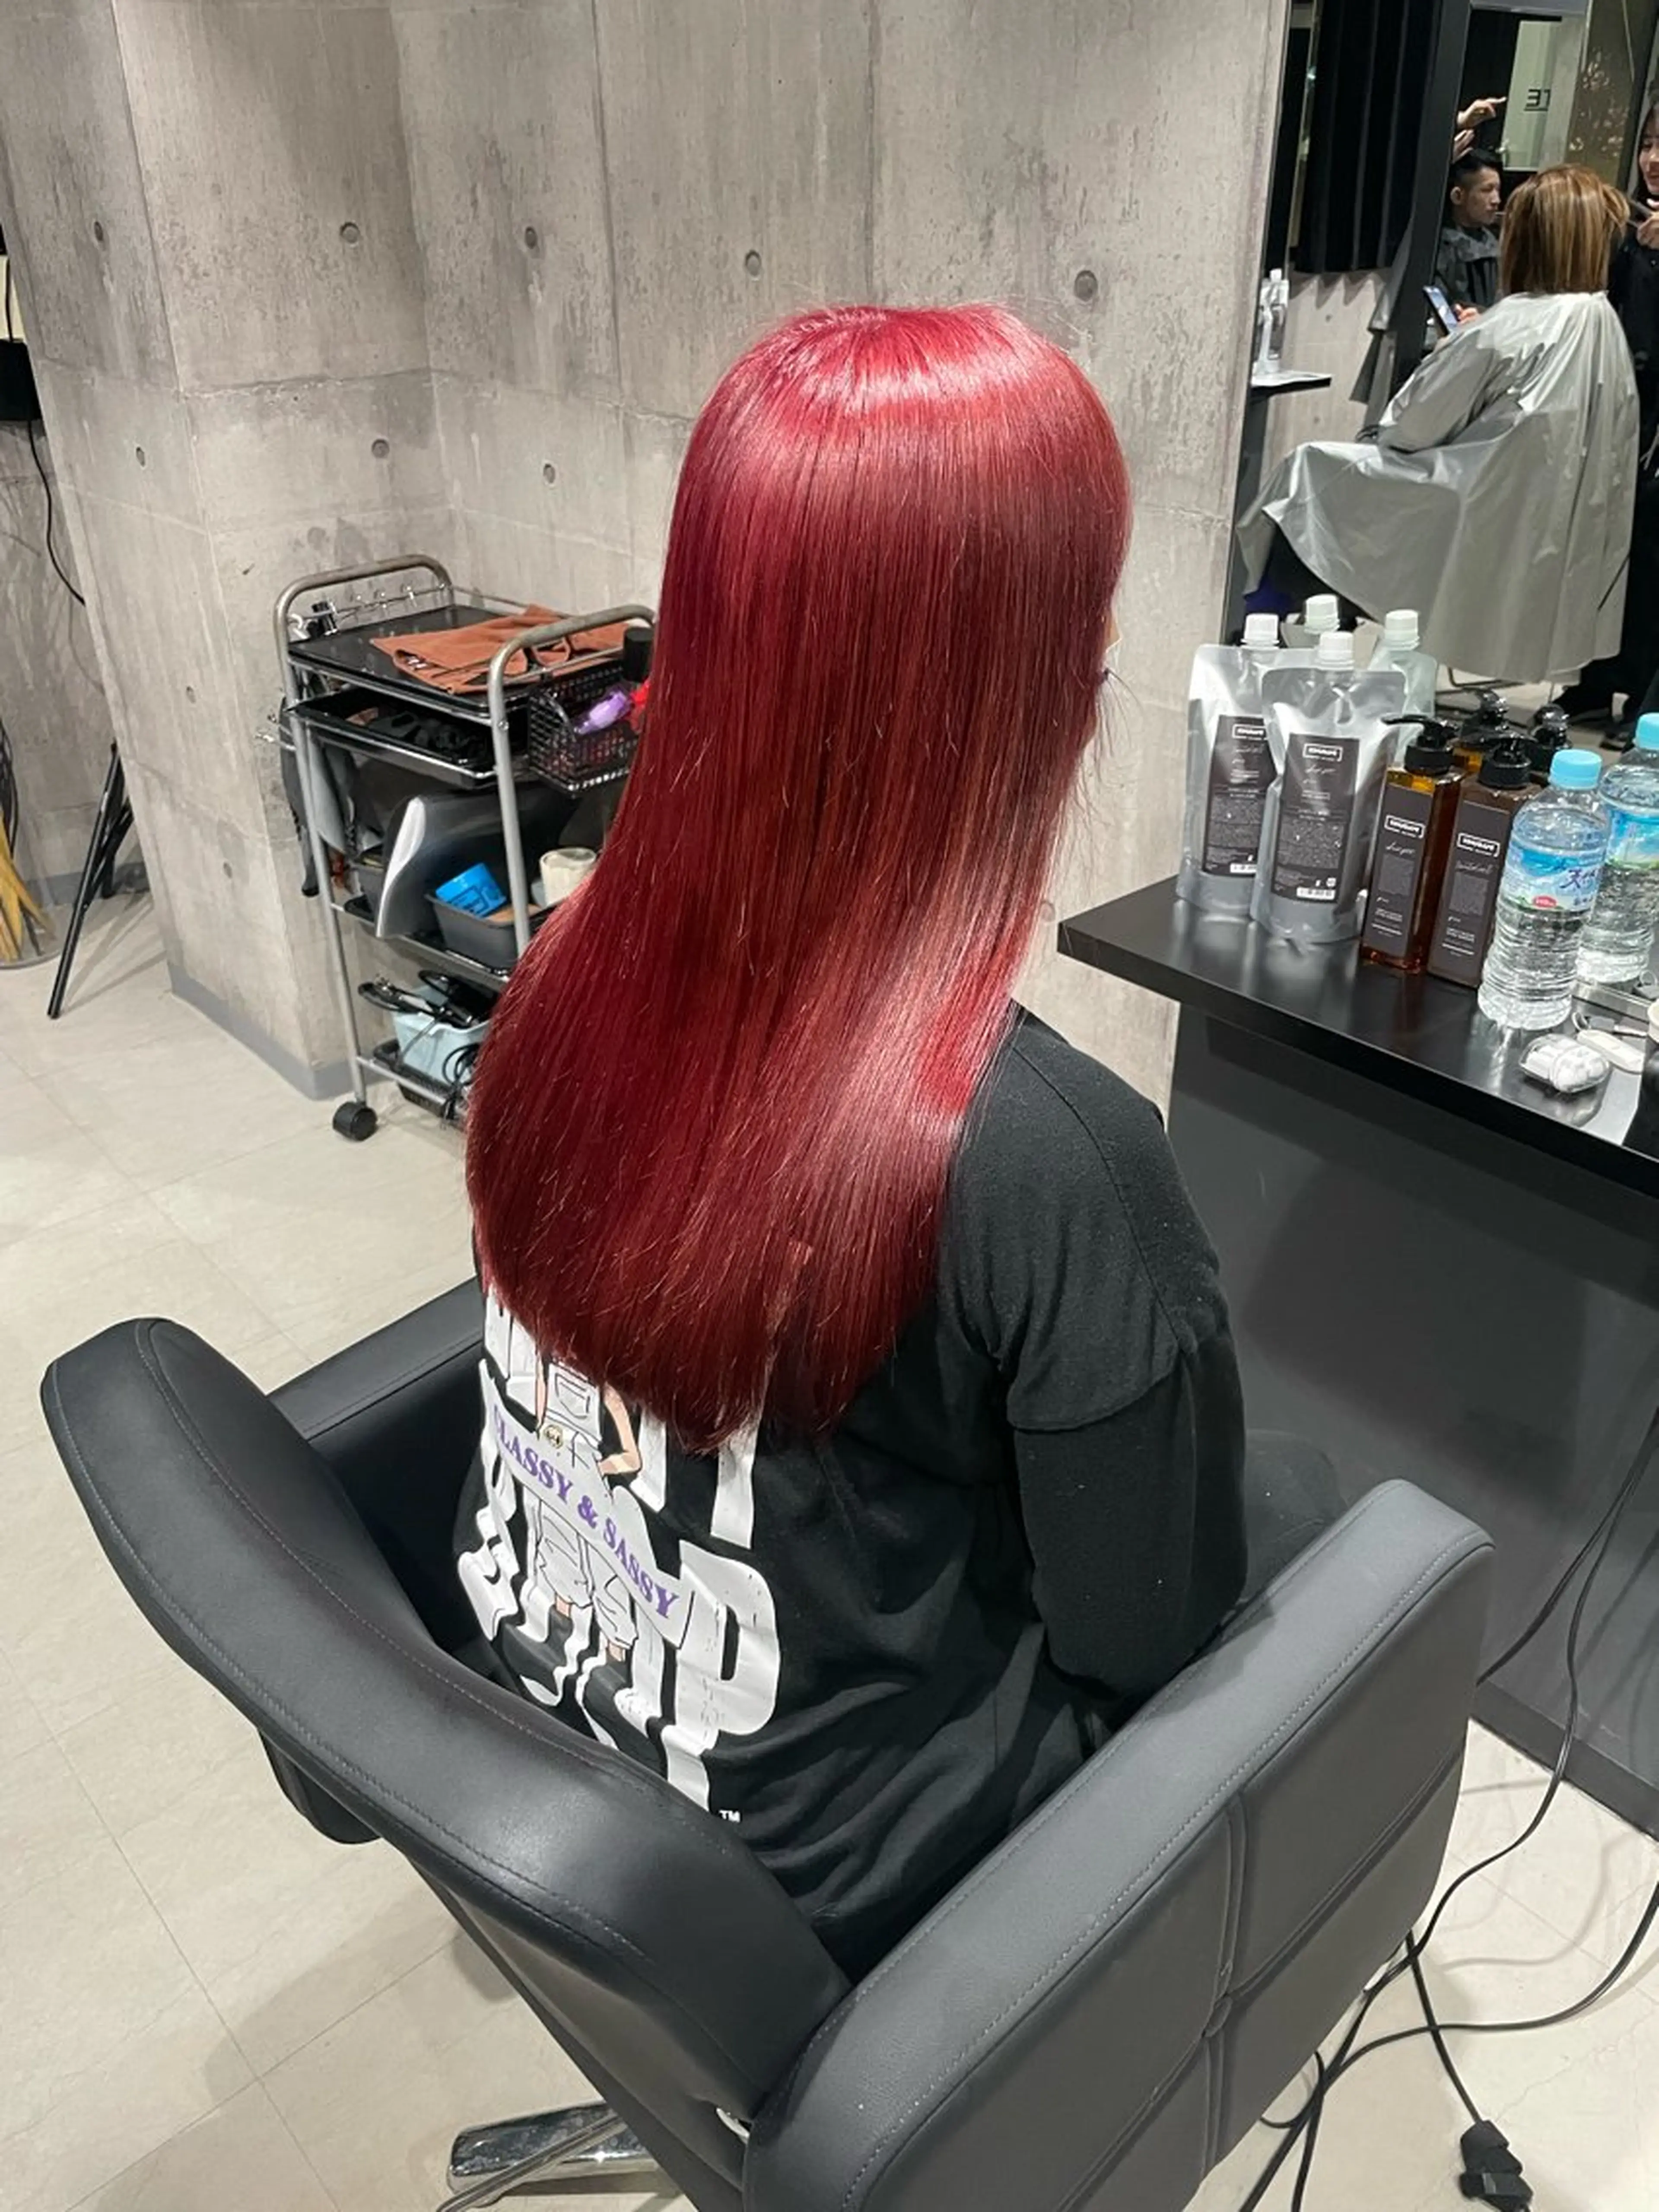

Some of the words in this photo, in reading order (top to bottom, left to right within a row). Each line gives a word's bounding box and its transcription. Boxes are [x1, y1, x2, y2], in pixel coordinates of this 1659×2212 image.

[577, 1495, 598, 1529] &
[603, 1517, 680, 1619] SASSY
[719, 1810, 741, 1823] TM
